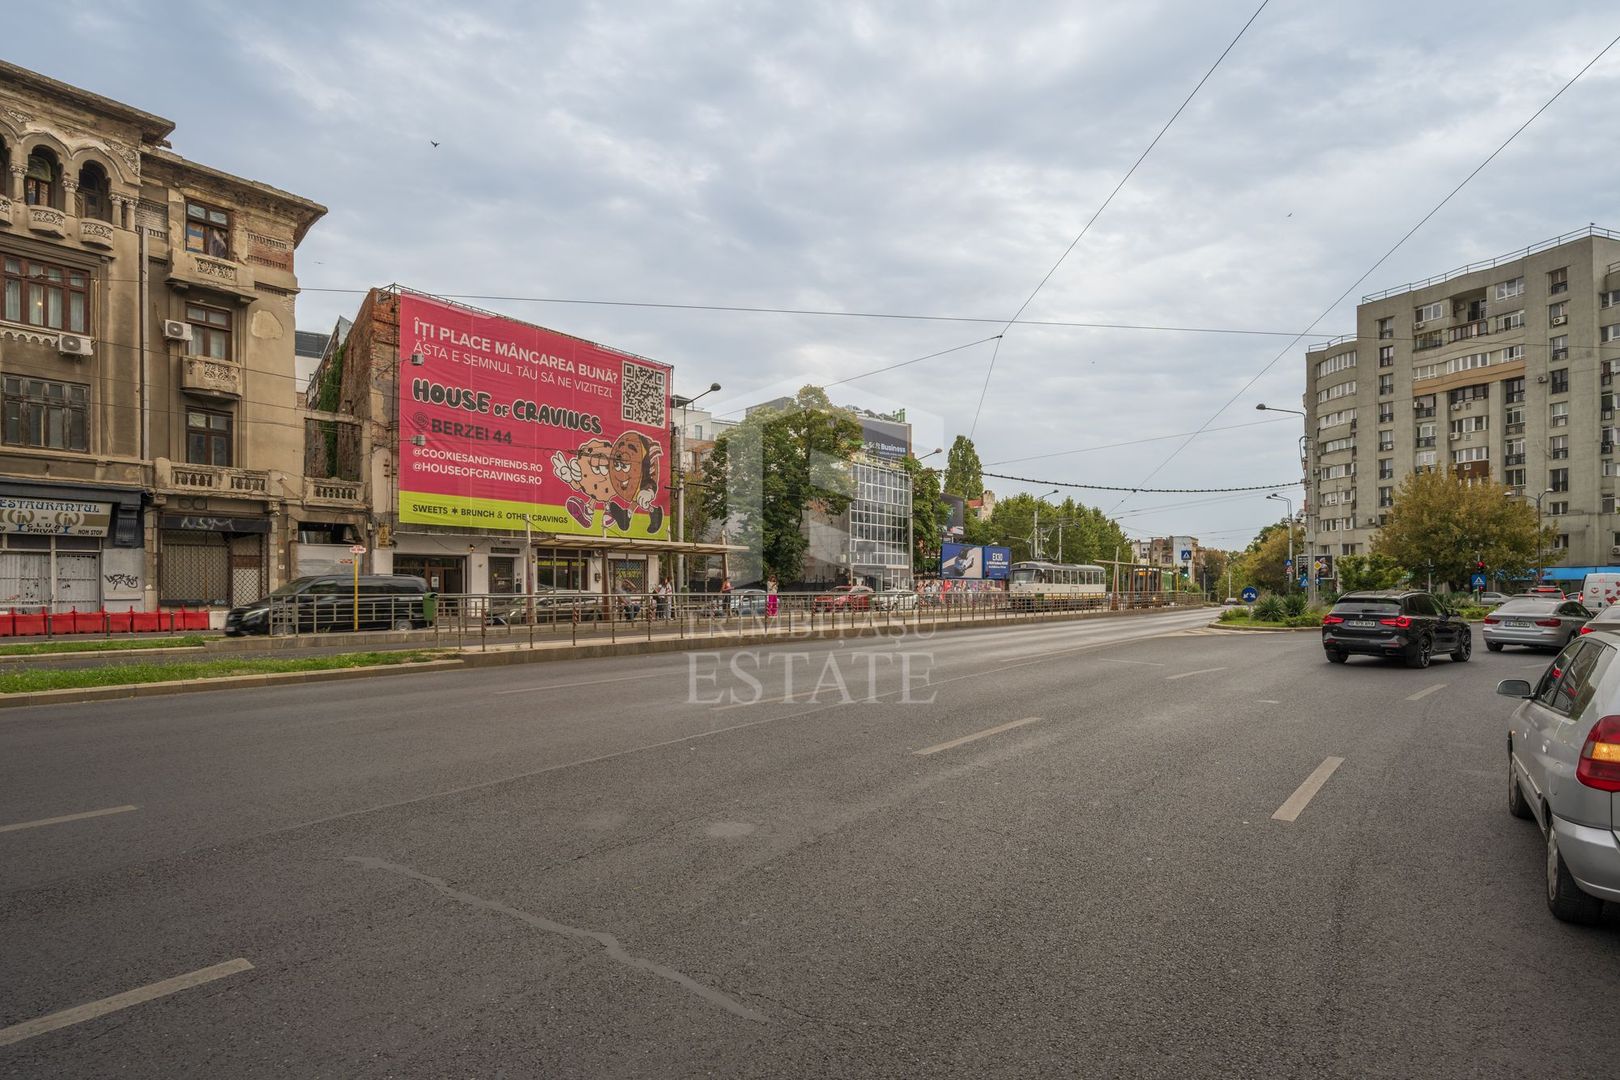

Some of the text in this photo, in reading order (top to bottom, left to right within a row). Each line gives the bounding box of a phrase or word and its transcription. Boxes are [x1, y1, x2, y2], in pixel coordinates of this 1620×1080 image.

[413, 337, 448, 360] ĂSTA
[452, 350, 459, 362] E
[463, 352, 513, 375] SEMNUL
[516, 364, 538, 381] TĂU
[540, 370, 555, 384] SĂ
[557, 375, 572, 389] NE
[439, 327, 491, 353] PLACE
[495, 341, 575, 374] MÂNCAREA
[578, 362, 618, 385] BUNĂ?
[412, 378, 603, 435] HOUSE OF CRAVINGS
[431, 418, 513, 444] BERZEI 44
[413, 448, 543, 473] @COOKIESANDFRIENDS.RO
[413, 462, 543, 486] @HOUSEOFCRAVINGS.RO
[412, 504, 448, 515] SWEETS
[461, 508, 495, 518] BRUNCH
[496, 511, 503, 519] &
[532, 514, 568, 524] CRAVINGS
